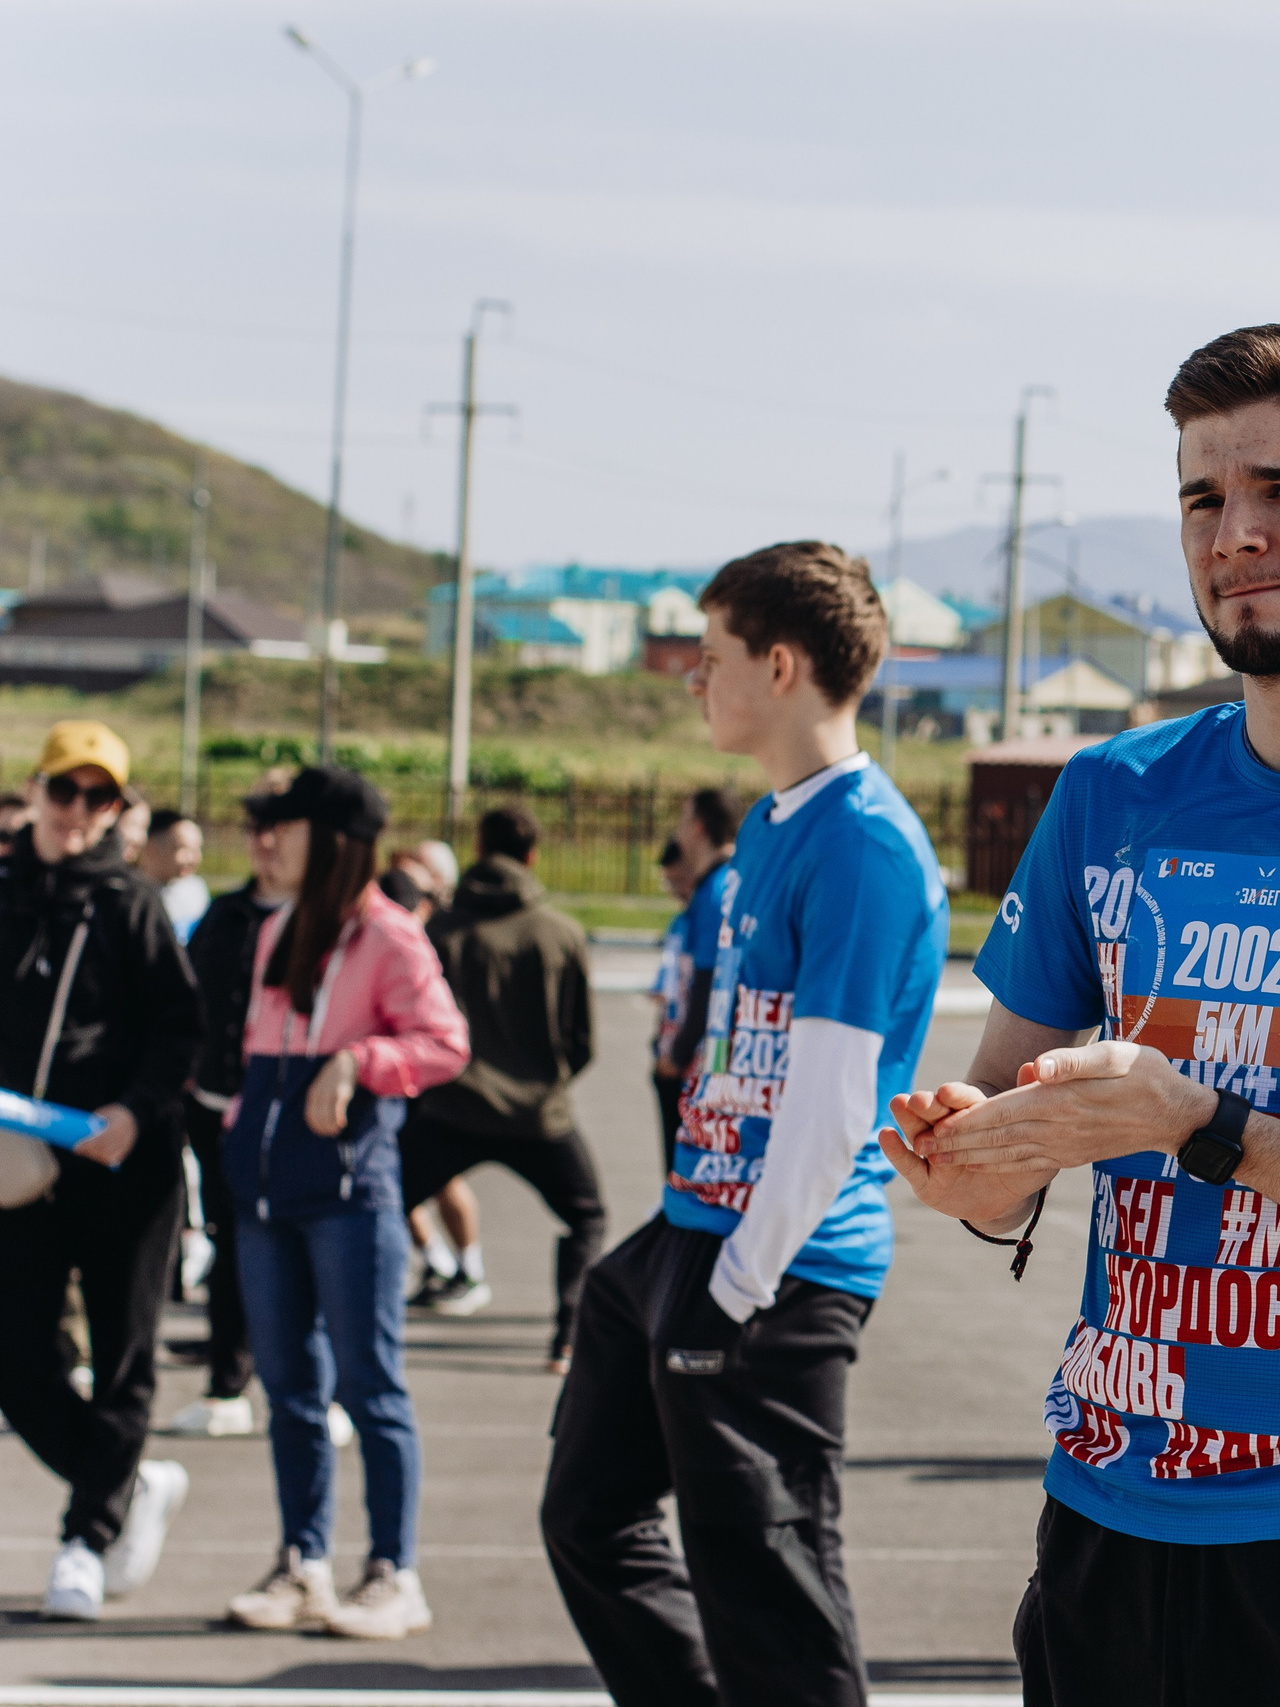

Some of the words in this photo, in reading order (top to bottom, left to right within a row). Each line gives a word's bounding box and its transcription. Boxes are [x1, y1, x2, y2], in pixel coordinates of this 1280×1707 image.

[1084, 865, 1143, 939] 20
[1181, 861, 1215, 878] ПСБ
[998, 892, 1023, 934] СБ
[1142, 991, 1158, 1021] #ТРЕПЕТ
[1152, 946, 1166, 991] #УДИВЛЕНИЕ
[1193, 1000, 1274, 1066] 5КМ
